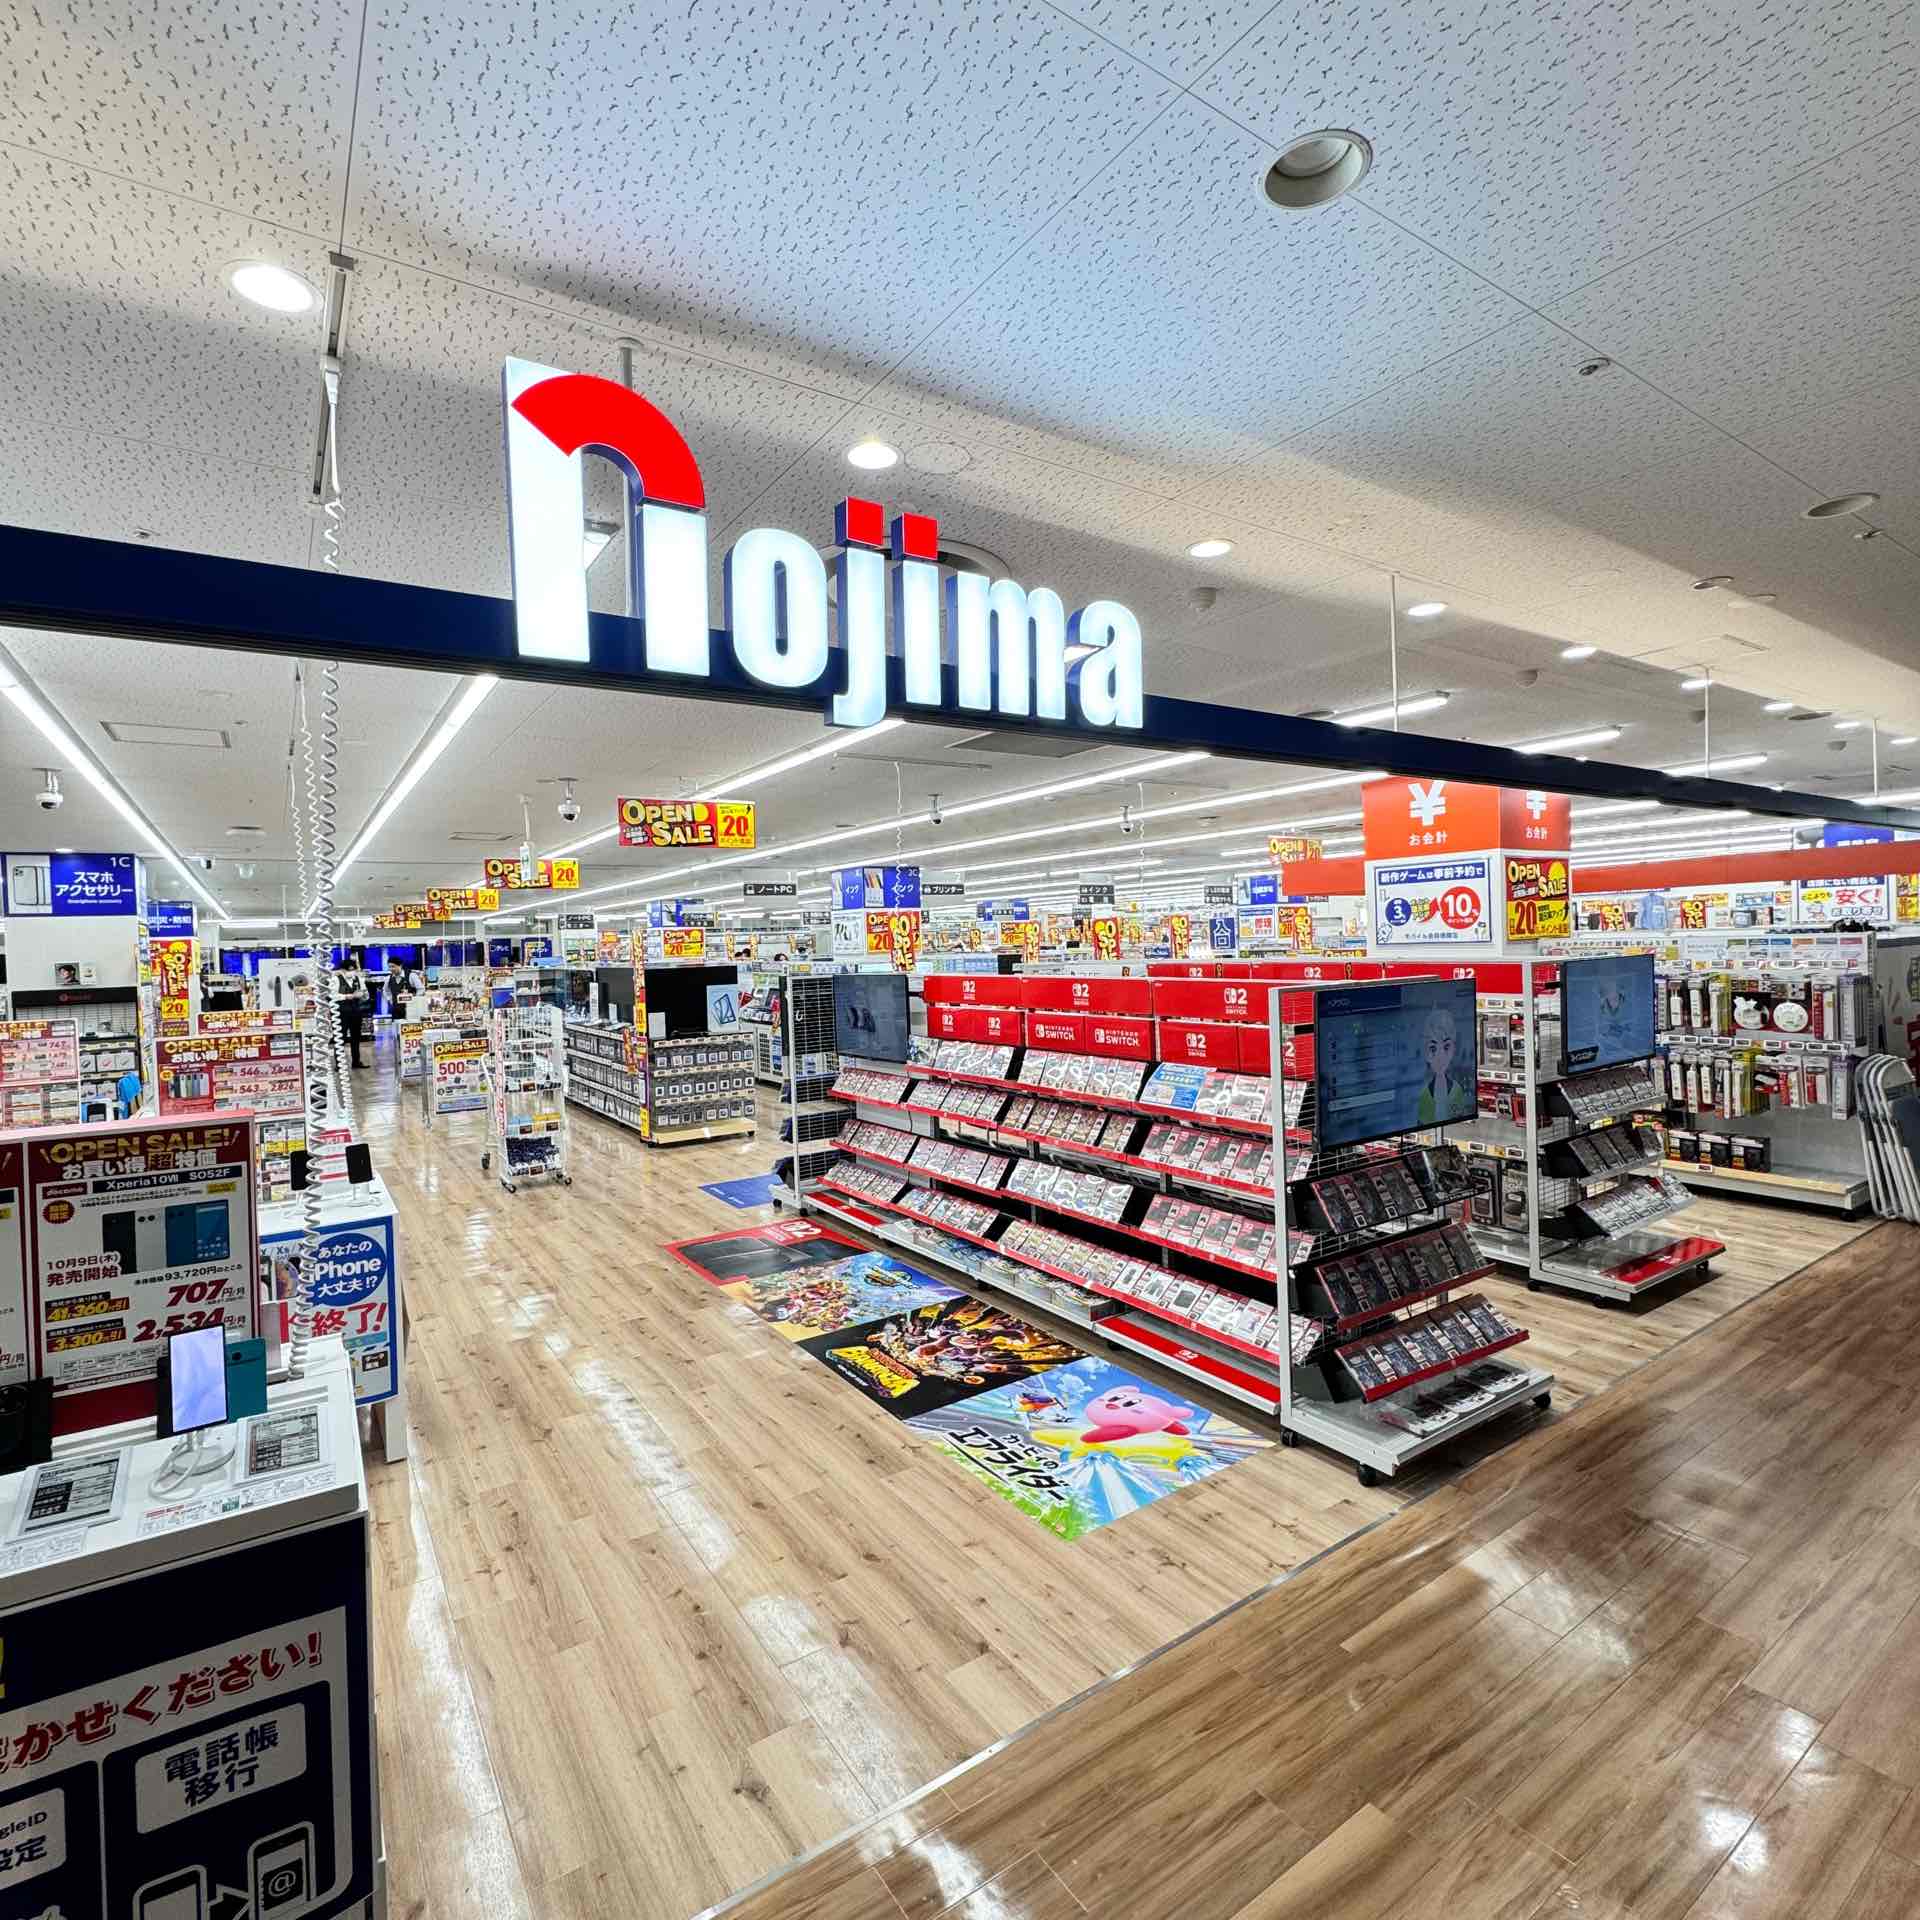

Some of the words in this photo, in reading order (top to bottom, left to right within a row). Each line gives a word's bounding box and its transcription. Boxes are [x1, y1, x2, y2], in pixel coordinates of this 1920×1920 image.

[503, 357, 1142, 729] nojima
[622, 799, 693, 826] OPEN
[651, 821, 714, 847] SALE
[723, 815, 749, 837] 20
[1525, 826, 1548, 840] お会計
[1409, 831, 1448, 846] お会計
[110, 857, 131, 867] 1C
[1508, 860, 1541, 883] OPEN
[74, 871, 115, 883] スマホ
[556, 868, 575, 881] 20
[55, 884, 133, 896] アクセサリー
[758, 885, 793, 894] ノートPC
[845, 885, 860, 894] インク
[932, 885, 963, 893] プリンター
[1538, 876, 1568, 898] SALE
[1515, 901, 1538, 935] 20
[1237, 988, 1248, 1004] 2
[166, 1003, 183, 1014] 20
[164, 1039, 215, 1053] OPEN
[438, 1061, 465, 1076] 500
[50, 1136, 140, 1164] OPEN
[147, 1127, 230, 1150] SALE!
[318, 1241, 373, 1260] あなたの
[47, 1265, 118, 1287] 発売開始
[1002, 1433, 1059, 1471] カービィの
[948, 1426, 1069, 1501] エアライダー
[0, 1632, 323, 1773] かせください!
[164, 1720, 280, 1784] 電話帳
[184, 1756, 260, 1808] 移行
